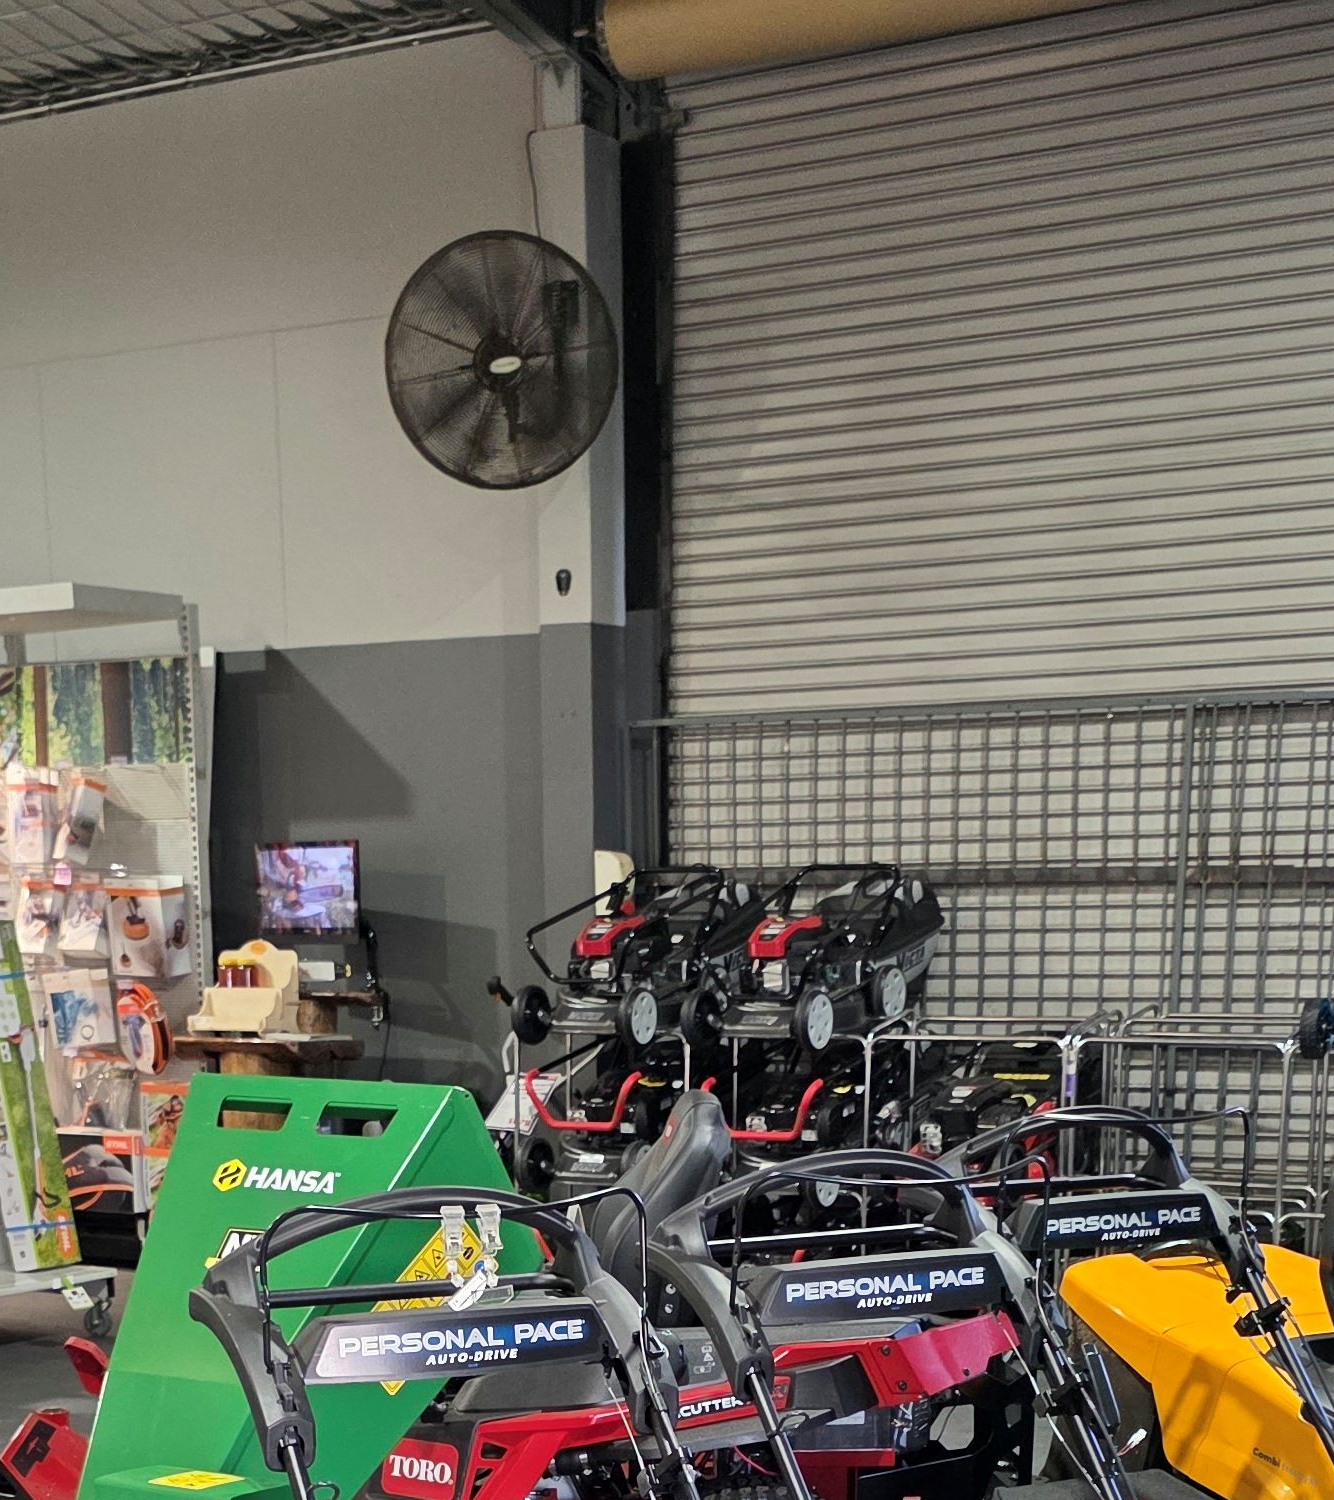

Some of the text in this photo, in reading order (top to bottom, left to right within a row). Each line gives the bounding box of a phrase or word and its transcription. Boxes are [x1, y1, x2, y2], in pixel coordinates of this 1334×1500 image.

[243, 1166, 335, 1194] HANSA
[1046, 1206, 1202, 1236] PERSONAL PACE
[1101, 1227, 1161, 1242] AUTO-DRIVE
[786, 1266, 985, 1303] PERSONAL PACE
[856, 1292, 933, 1309] AUTO-DRIVE
[338, 1319, 585, 1358] PERSONAL PACE
[425, 1348, 519, 1366] AUTO-DRIVE
[389, 1454, 453, 1485] TORO
[1252, 1447, 1281, 1468] Combi
